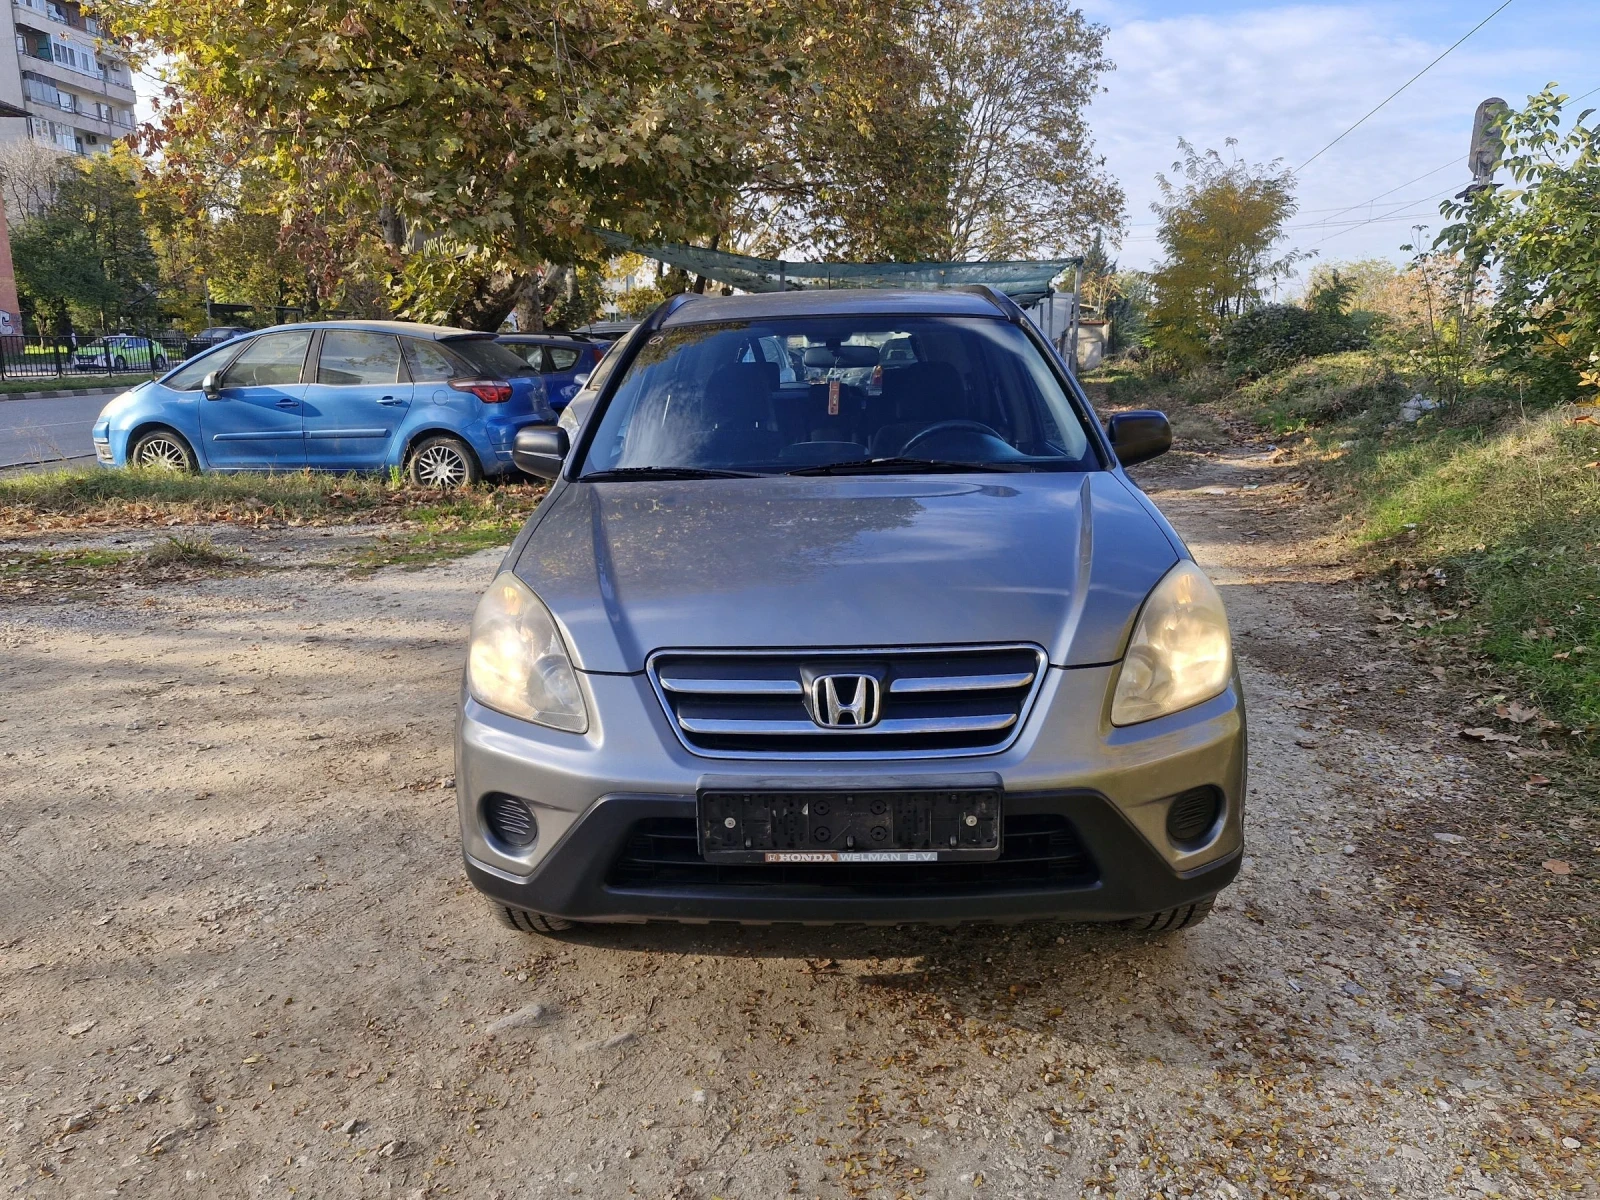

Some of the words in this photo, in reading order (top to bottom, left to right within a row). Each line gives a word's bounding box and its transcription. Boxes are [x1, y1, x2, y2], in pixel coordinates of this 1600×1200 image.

[779, 853, 835, 862] HONDA
[839, 853, 902, 862] WELMAN
[907, 852, 937, 861] B.V.
